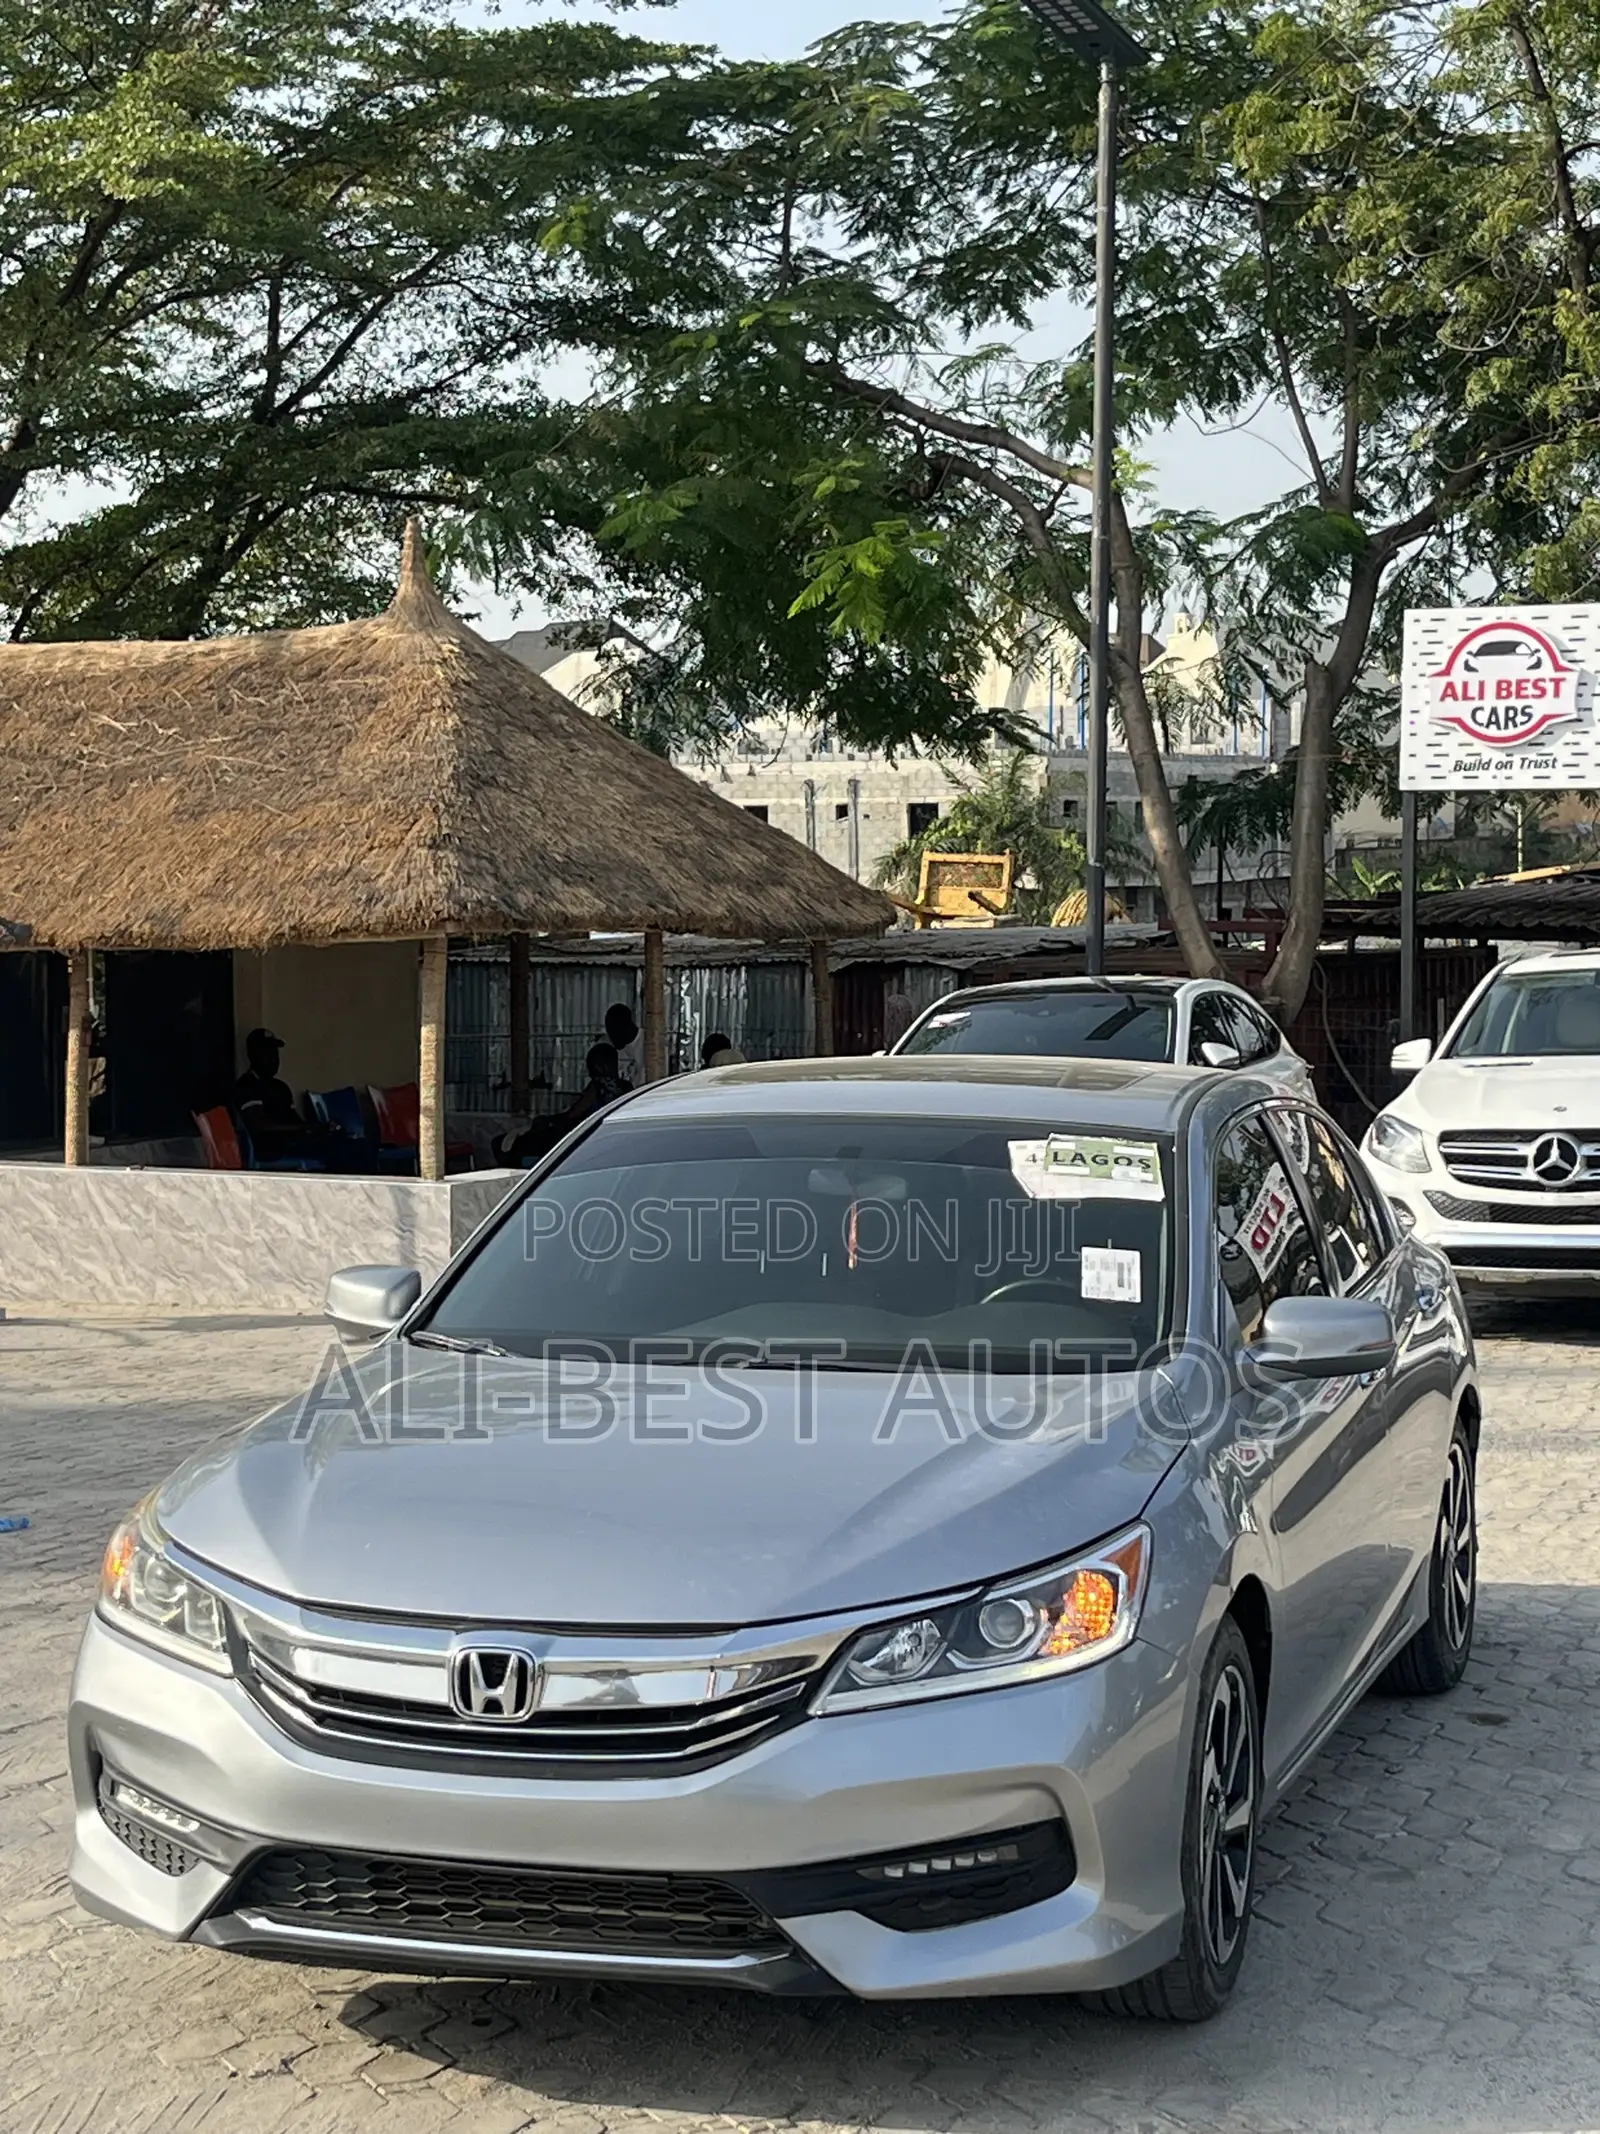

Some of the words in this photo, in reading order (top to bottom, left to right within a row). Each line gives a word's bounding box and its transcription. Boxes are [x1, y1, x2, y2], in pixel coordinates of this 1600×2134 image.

[1439, 679, 1485, 702] ALI
[1495, 677, 1567, 701] BEST
[1470, 704, 1534, 731] CARS
[1453, 757, 1491, 772] Build
[1494, 760, 1514, 770] on
[1518, 756, 1558, 770] Trust
[1052, 1150, 1152, 1170] LAGOS
